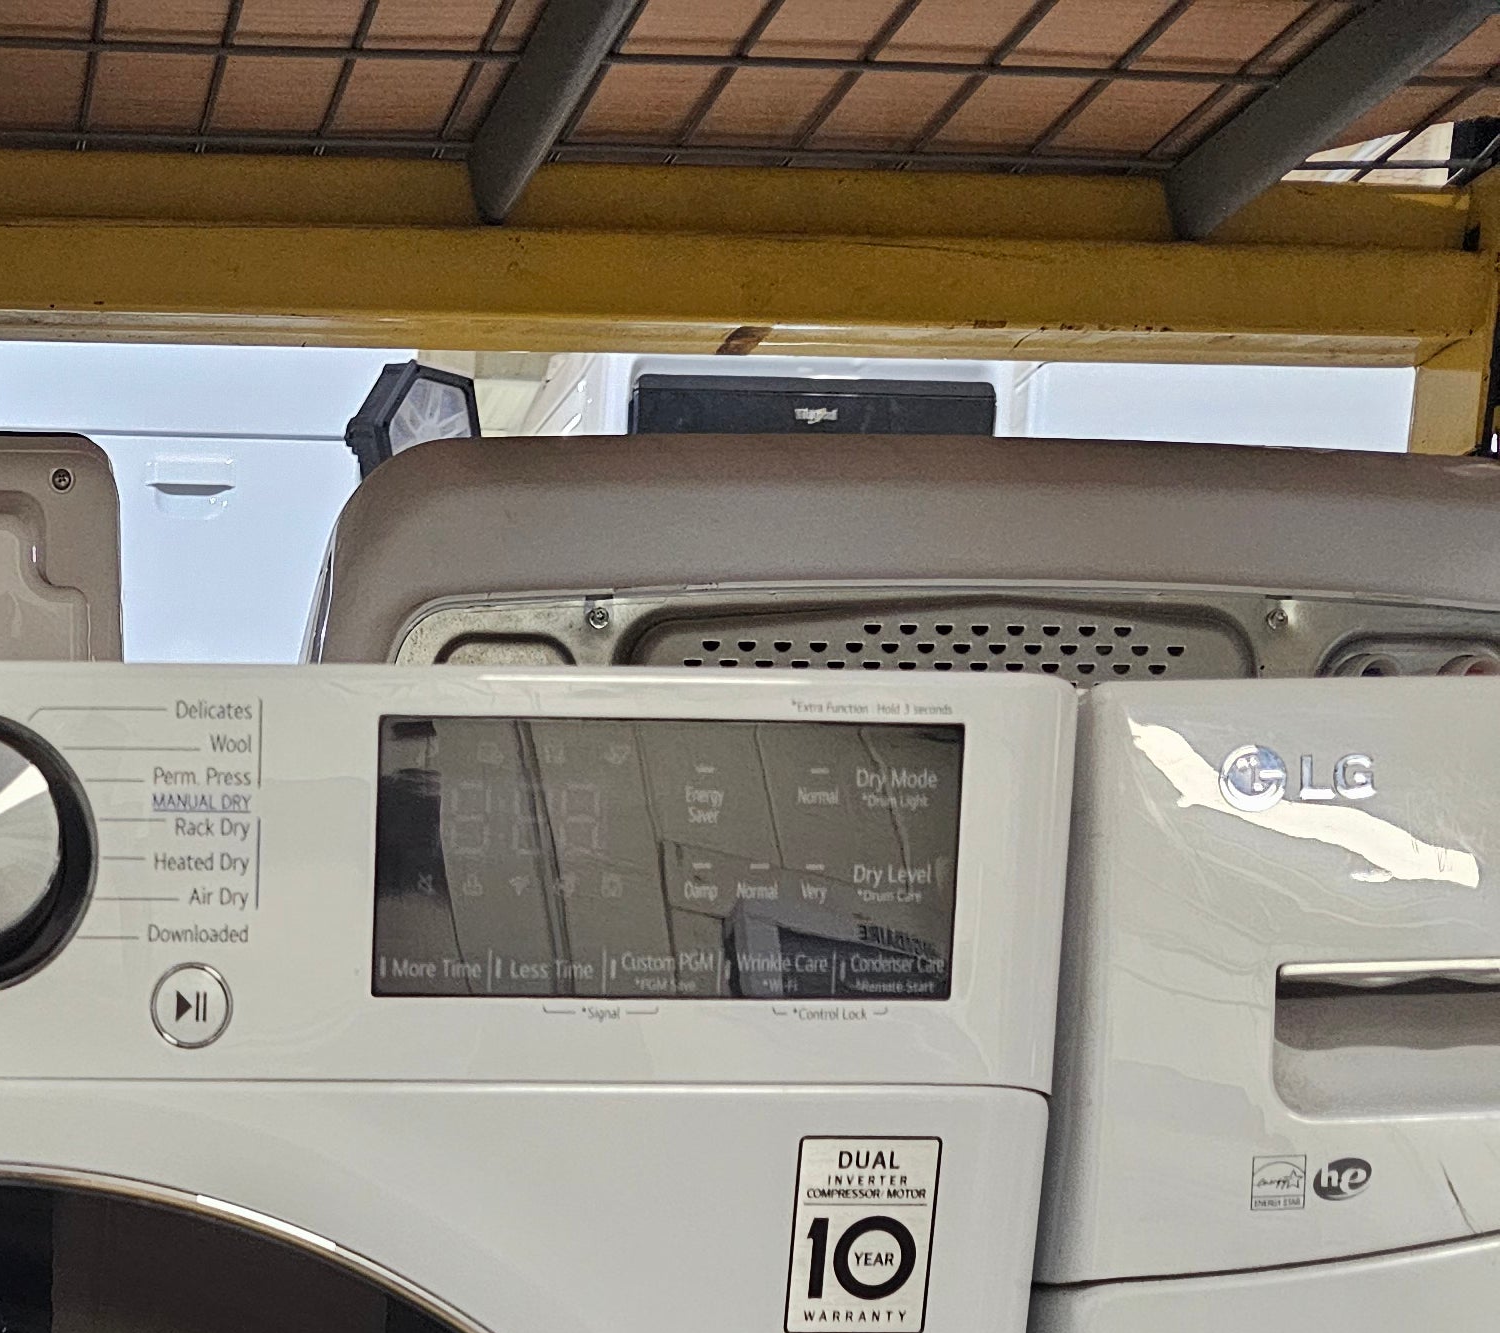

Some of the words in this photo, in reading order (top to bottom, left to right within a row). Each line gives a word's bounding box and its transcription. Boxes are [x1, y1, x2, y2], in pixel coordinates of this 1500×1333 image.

[176, 699, 253, 720] Delicates
[209, 733, 252, 753] Wool
[206, 767, 252, 786] Press
[856, 766, 886, 791] Dry
[891, 767, 938, 789] Mode
[1300, 753, 1377, 800] LG
[152, 793, 216, 811] MANUAL
[221, 793, 252, 811] DRY
[798, 785, 839, 805] Normal
[174, 817, 215, 837] Rack
[220, 817, 250, 841] Dry
[153, 851, 214, 871] Heated
[220, 852, 250, 876] Dry
[853, 864, 883, 889] Dry
[888, 864, 932, 885] Level
[188, 886, 213, 905] Air
[220, 886, 249, 911] Dry
[684, 880, 718, 901] Damp
[736, 880, 779, 900] Normal
[801, 880, 827, 904] Very
[147, 923, 249, 943] Downloaded
[392, 958, 436, 979] More
[443, 959, 482, 979] Time
[510, 959, 548, 979] Less
[556, 959, 595, 980] Time
[621, 951, 676, 972] Custom
[679, 952, 714, 972] PGM
[737, 952, 791, 973] Wrinkle
[795, 954, 829, 973] Care
[842, 1007, 867, 1020] Lock
[838, 1150, 900, 1170] DUAL
[827, 1175, 908, 1186] INVERTER
[806, 1215, 917, 1301] 10
[854, 1252, 895, 1267] YEAR
[803, 1310, 907, 1323] WARRANTY
